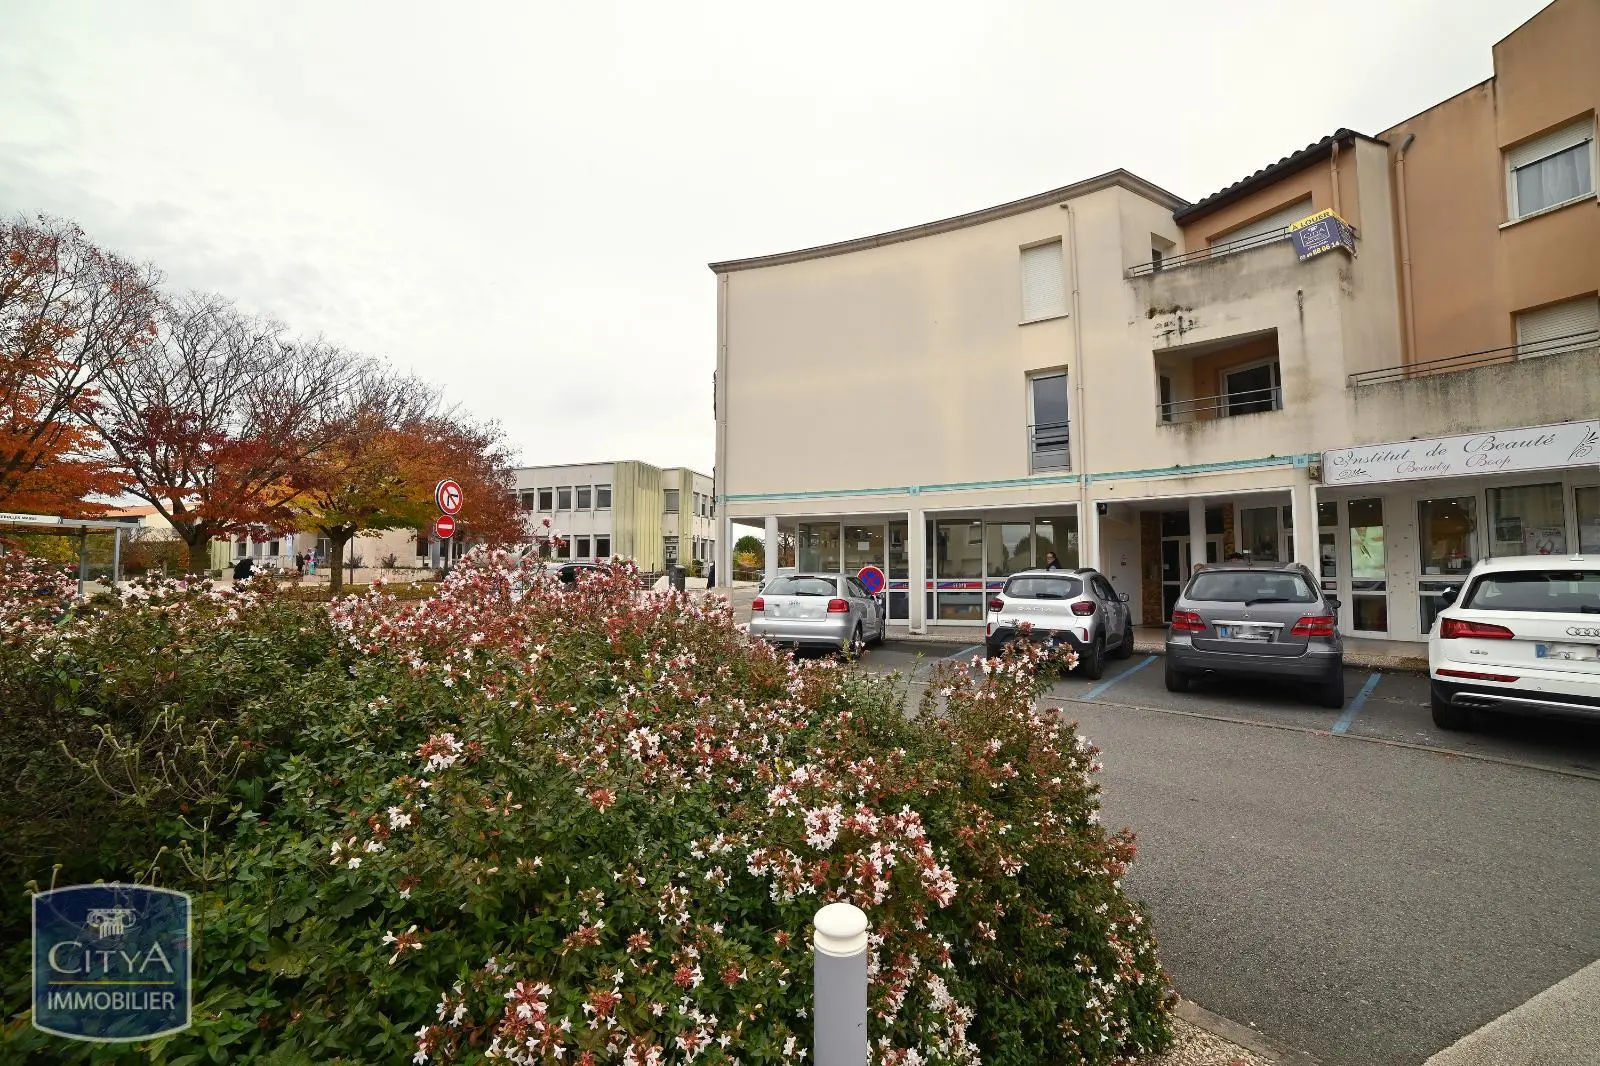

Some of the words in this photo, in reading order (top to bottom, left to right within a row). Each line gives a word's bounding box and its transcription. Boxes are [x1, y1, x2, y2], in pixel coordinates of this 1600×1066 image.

[1300, 211, 1330, 227] LOUER
[1333, 450, 1410, 467] Institut
[1426, 442, 1448, 458] de
[1463, 432, 1556, 454] Beauté
[1396, 460, 1451, 475] Beauty
